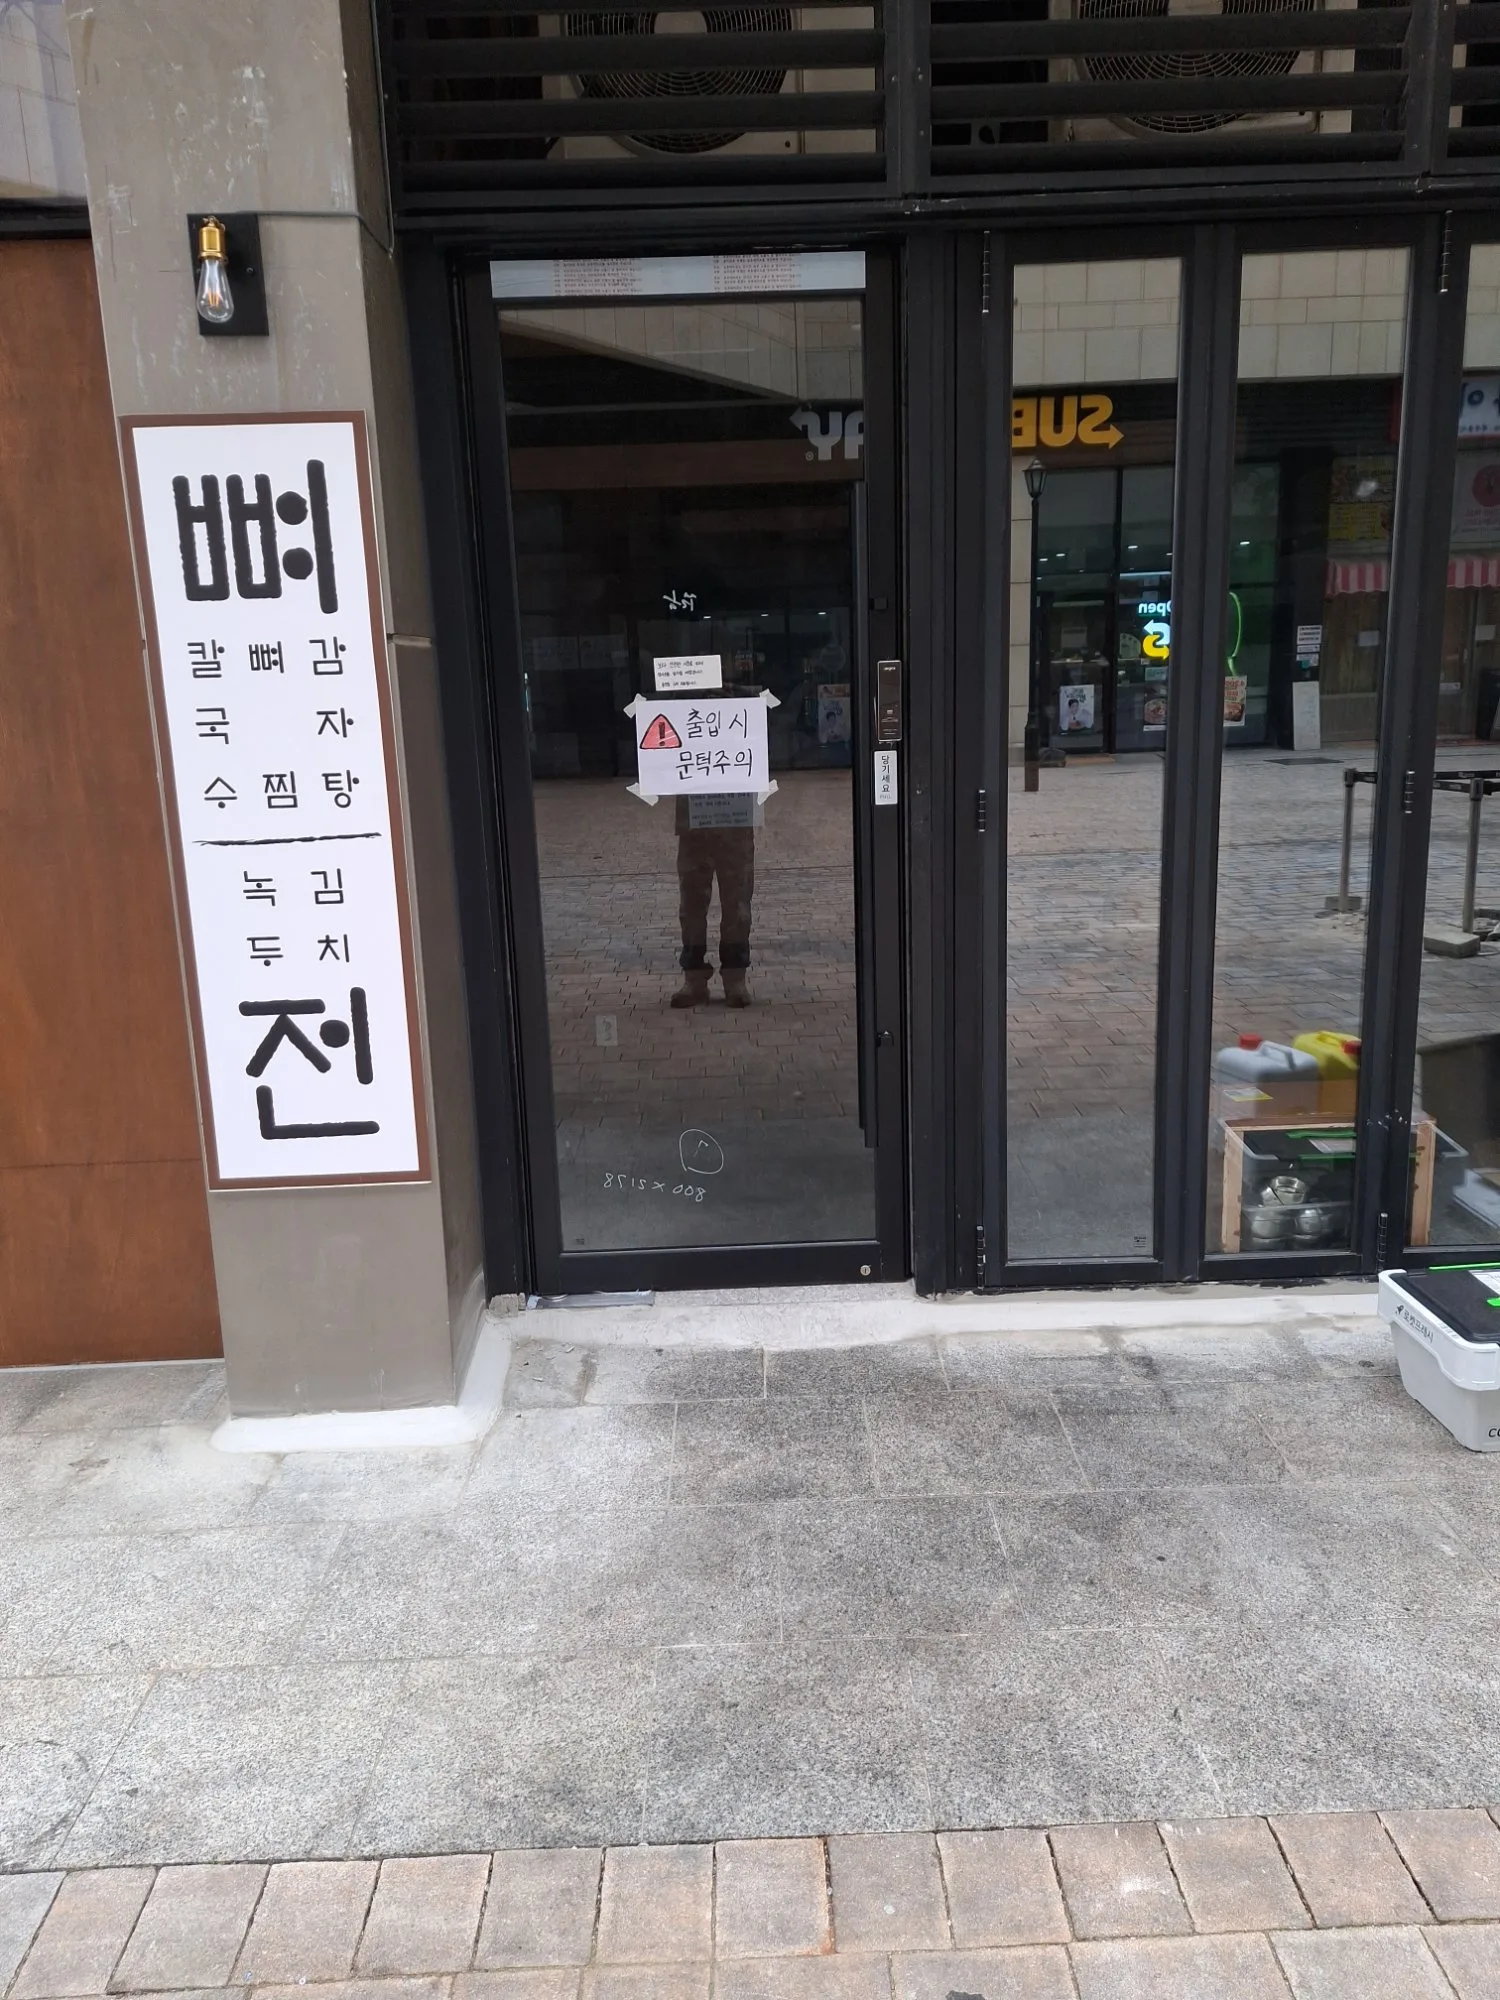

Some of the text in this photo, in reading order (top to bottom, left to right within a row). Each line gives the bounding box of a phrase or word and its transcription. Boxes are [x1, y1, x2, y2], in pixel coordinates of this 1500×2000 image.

[172, 459, 339, 614] 뼈
[187, 639, 238, 810] 칼국수
[248, 641, 299, 809] 뼈찜
[309, 637, 360, 809] 감자탕
[675, 748, 753, 780] 문턱주의
[686, 708, 748, 740] 출입 시
[881, 755, 891, 793] 당기세요
[243, 870, 284, 967] 녹두
[311, 868, 351, 963] 김치
[239, 986, 380, 1140] 전
[1403, 1309, 1434, 1343] 로켓프레시
